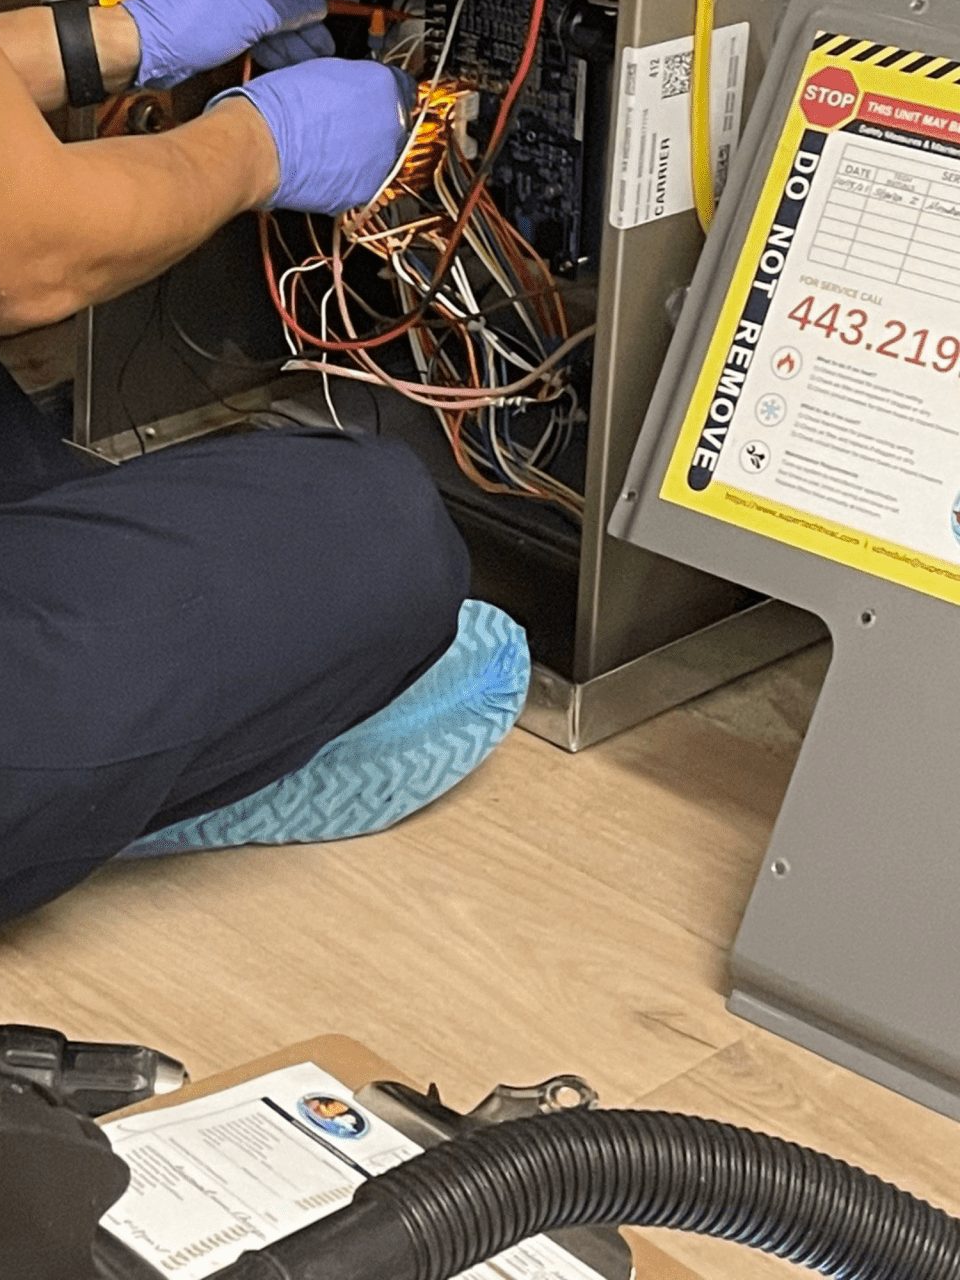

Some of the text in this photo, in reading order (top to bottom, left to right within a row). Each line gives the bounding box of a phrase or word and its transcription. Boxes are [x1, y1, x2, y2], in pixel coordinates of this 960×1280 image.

[804, 85, 855, 109] STOP
[867, 101, 894, 117] THIS
[894, 108, 921, 123] UNIT
[922, 115, 950, 129] MAY
[655, 136, 671, 216] CARRIER
[845, 164, 872, 179] DATE
[800, 275, 883, 306] FOR SERVICE CALL
[692, 151, 820, 472] DO NOT REMOVE
